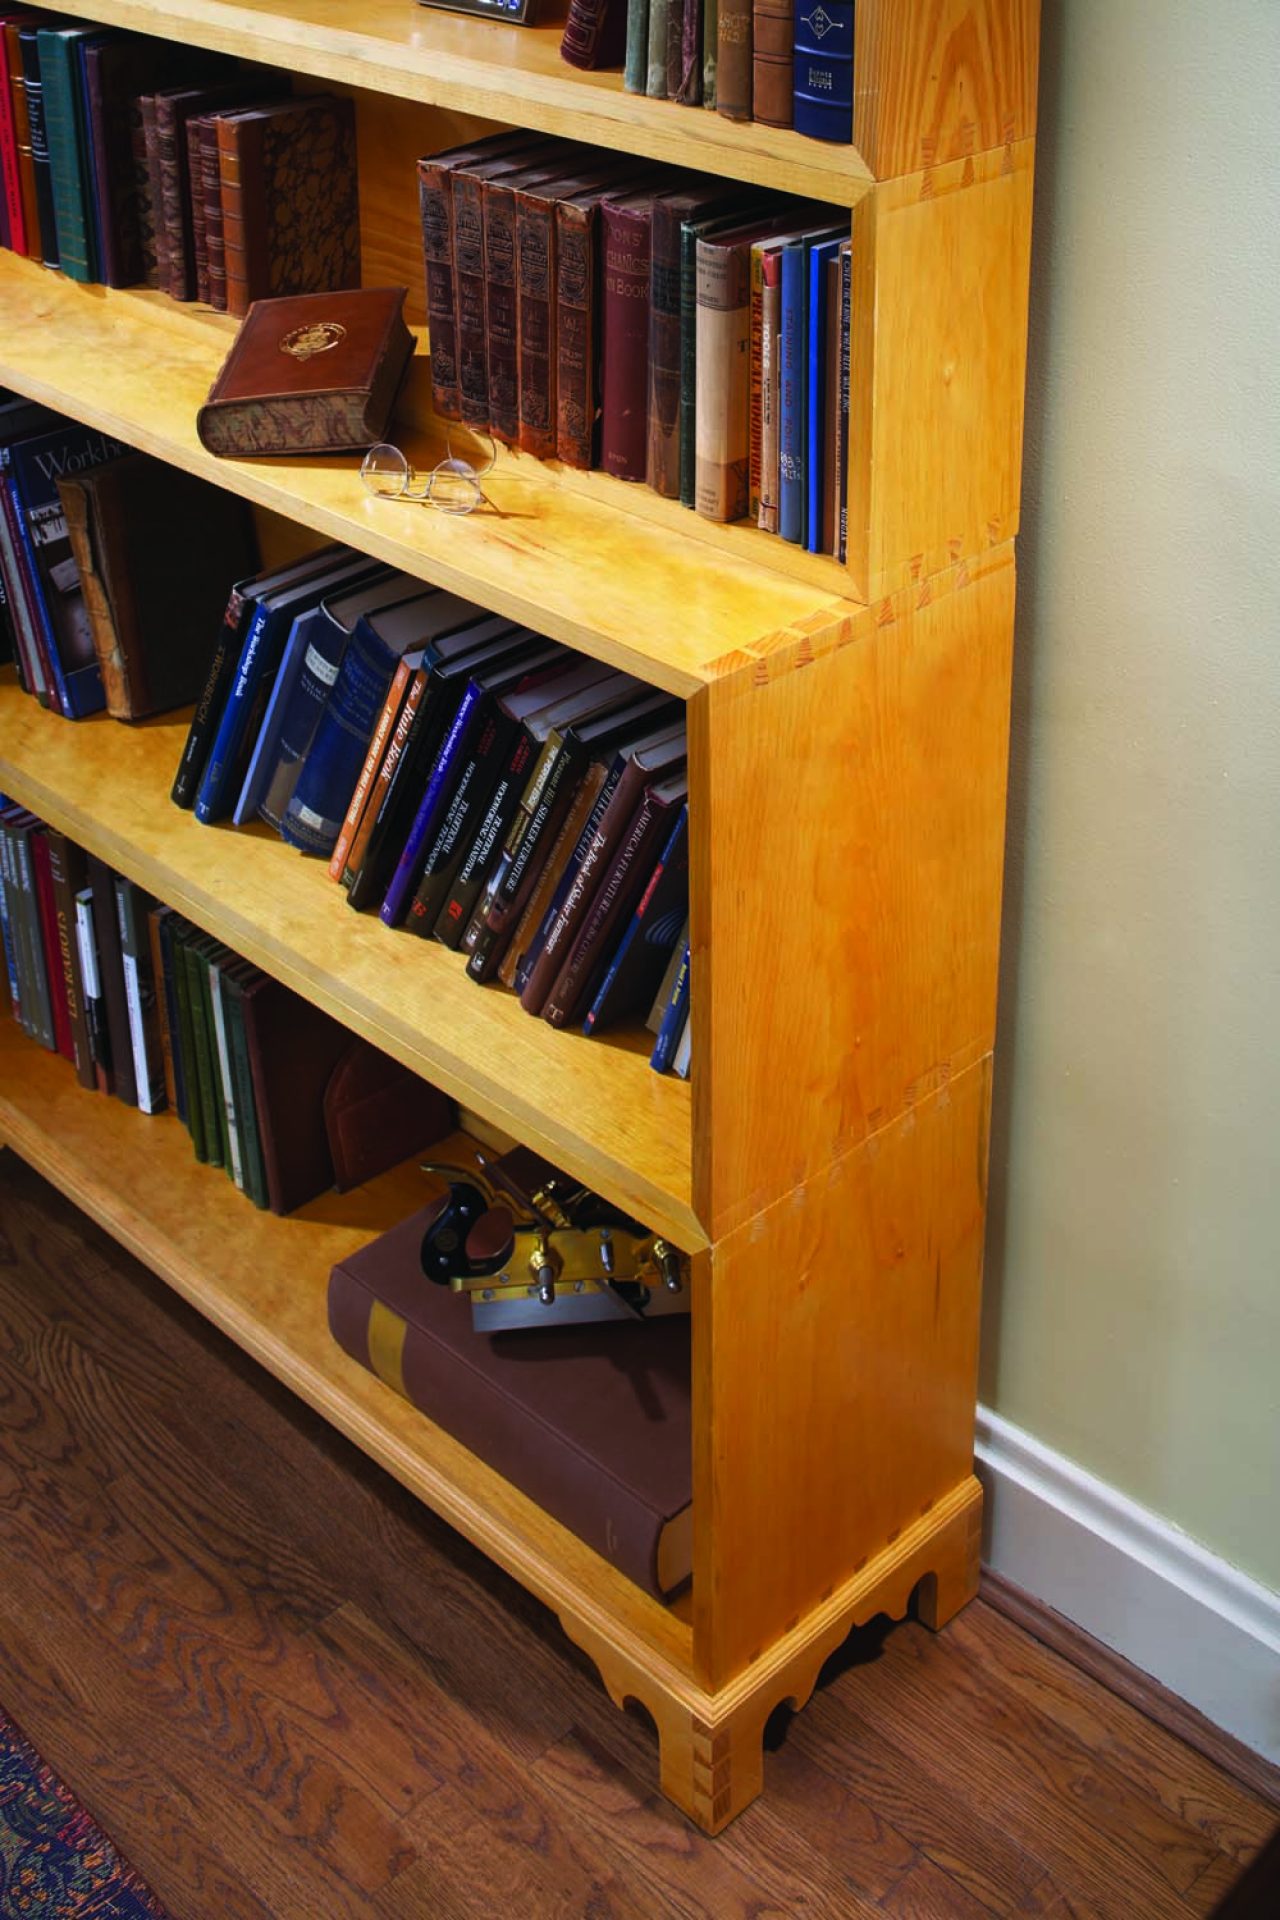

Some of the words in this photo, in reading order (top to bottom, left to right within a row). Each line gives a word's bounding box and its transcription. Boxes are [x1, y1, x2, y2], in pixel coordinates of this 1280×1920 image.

[751, 291, 762, 387] PRACTICAL
[762, 324, 770, 369] TOOLS
[784, 308, 793, 369] STAINING
[784, 380, 793, 407] AND
[750, 392, 762, 488] WOODWORK
[253, 617, 265, 634] The
[240, 634, 259, 675] Workshop
[196, 652, 224, 725] WORKBENCH
[234, 675, 247, 697] Book
[408, 679, 422, 701] The
[393, 703, 416, 742] Rule
[378, 739, 403, 782] Book
[548, 750, 572, 789] Pleasant
[444, 759, 476, 824] WOODWORKING
[477, 778, 509, 839] WOODWORKING
[541, 786, 557, 805] Hill
[590, 780, 616, 823] SHAKER
[440, 799, 470, 854] TRADITIONAL
[477, 813, 503, 866] TRADITIONAL
[526, 803, 549, 842] SHAKER
[590, 832, 607, 853] The
[626, 808, 654, 861] AMERICAN
[422, 822, 450, 876] TECHNIQUES
[458, 835, 486, 885] HANDTOOLS
[504, 839, 533, 892] FURNITURE
[579, 849, 599, 876] Book
[561, 885, 582, 916] Shaker
[574, 874, 588, 888] of
[599, 859, 629, 914] FURNITURE
[54, 910, 75, 985] RABOTS
[542, 912, 569, 956] Furniture
[66, 987, 79, 1018] LES
